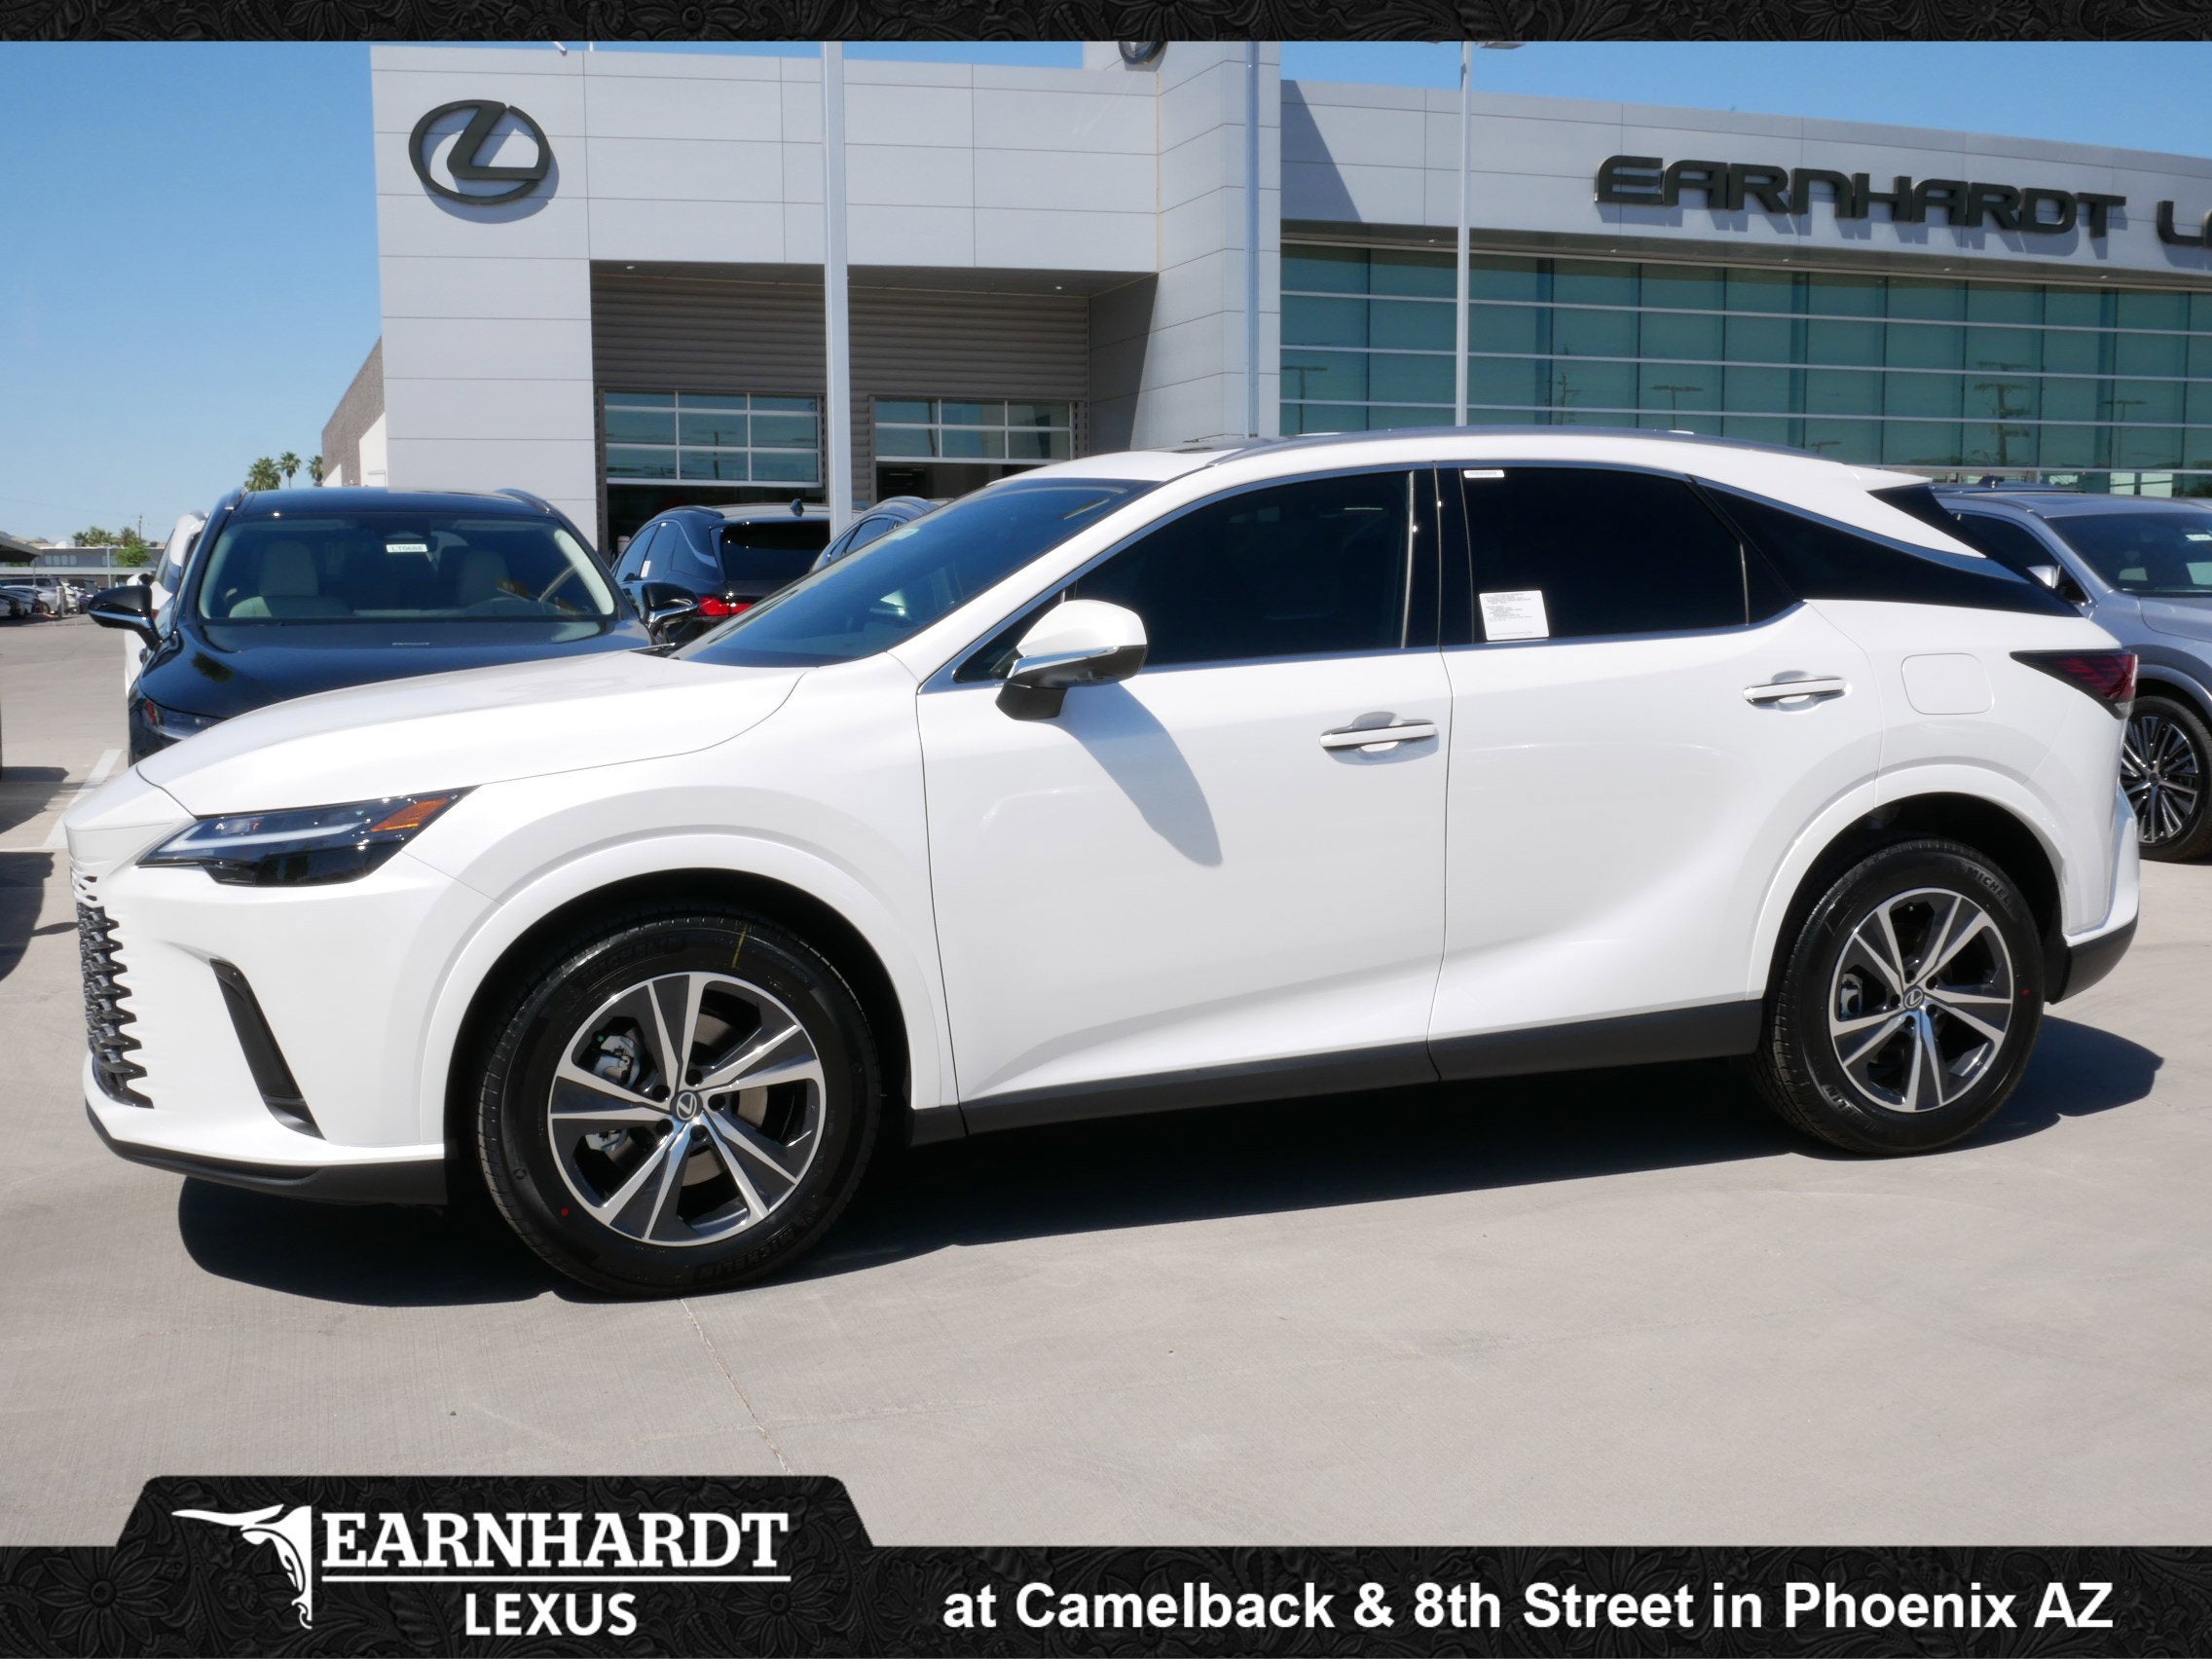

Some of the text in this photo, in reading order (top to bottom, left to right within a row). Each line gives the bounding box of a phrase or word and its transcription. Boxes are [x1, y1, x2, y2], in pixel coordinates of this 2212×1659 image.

[1595, 154, 2212, 249] EARNHARDT L
[1967, 866, 2015, 913] MICHEL
